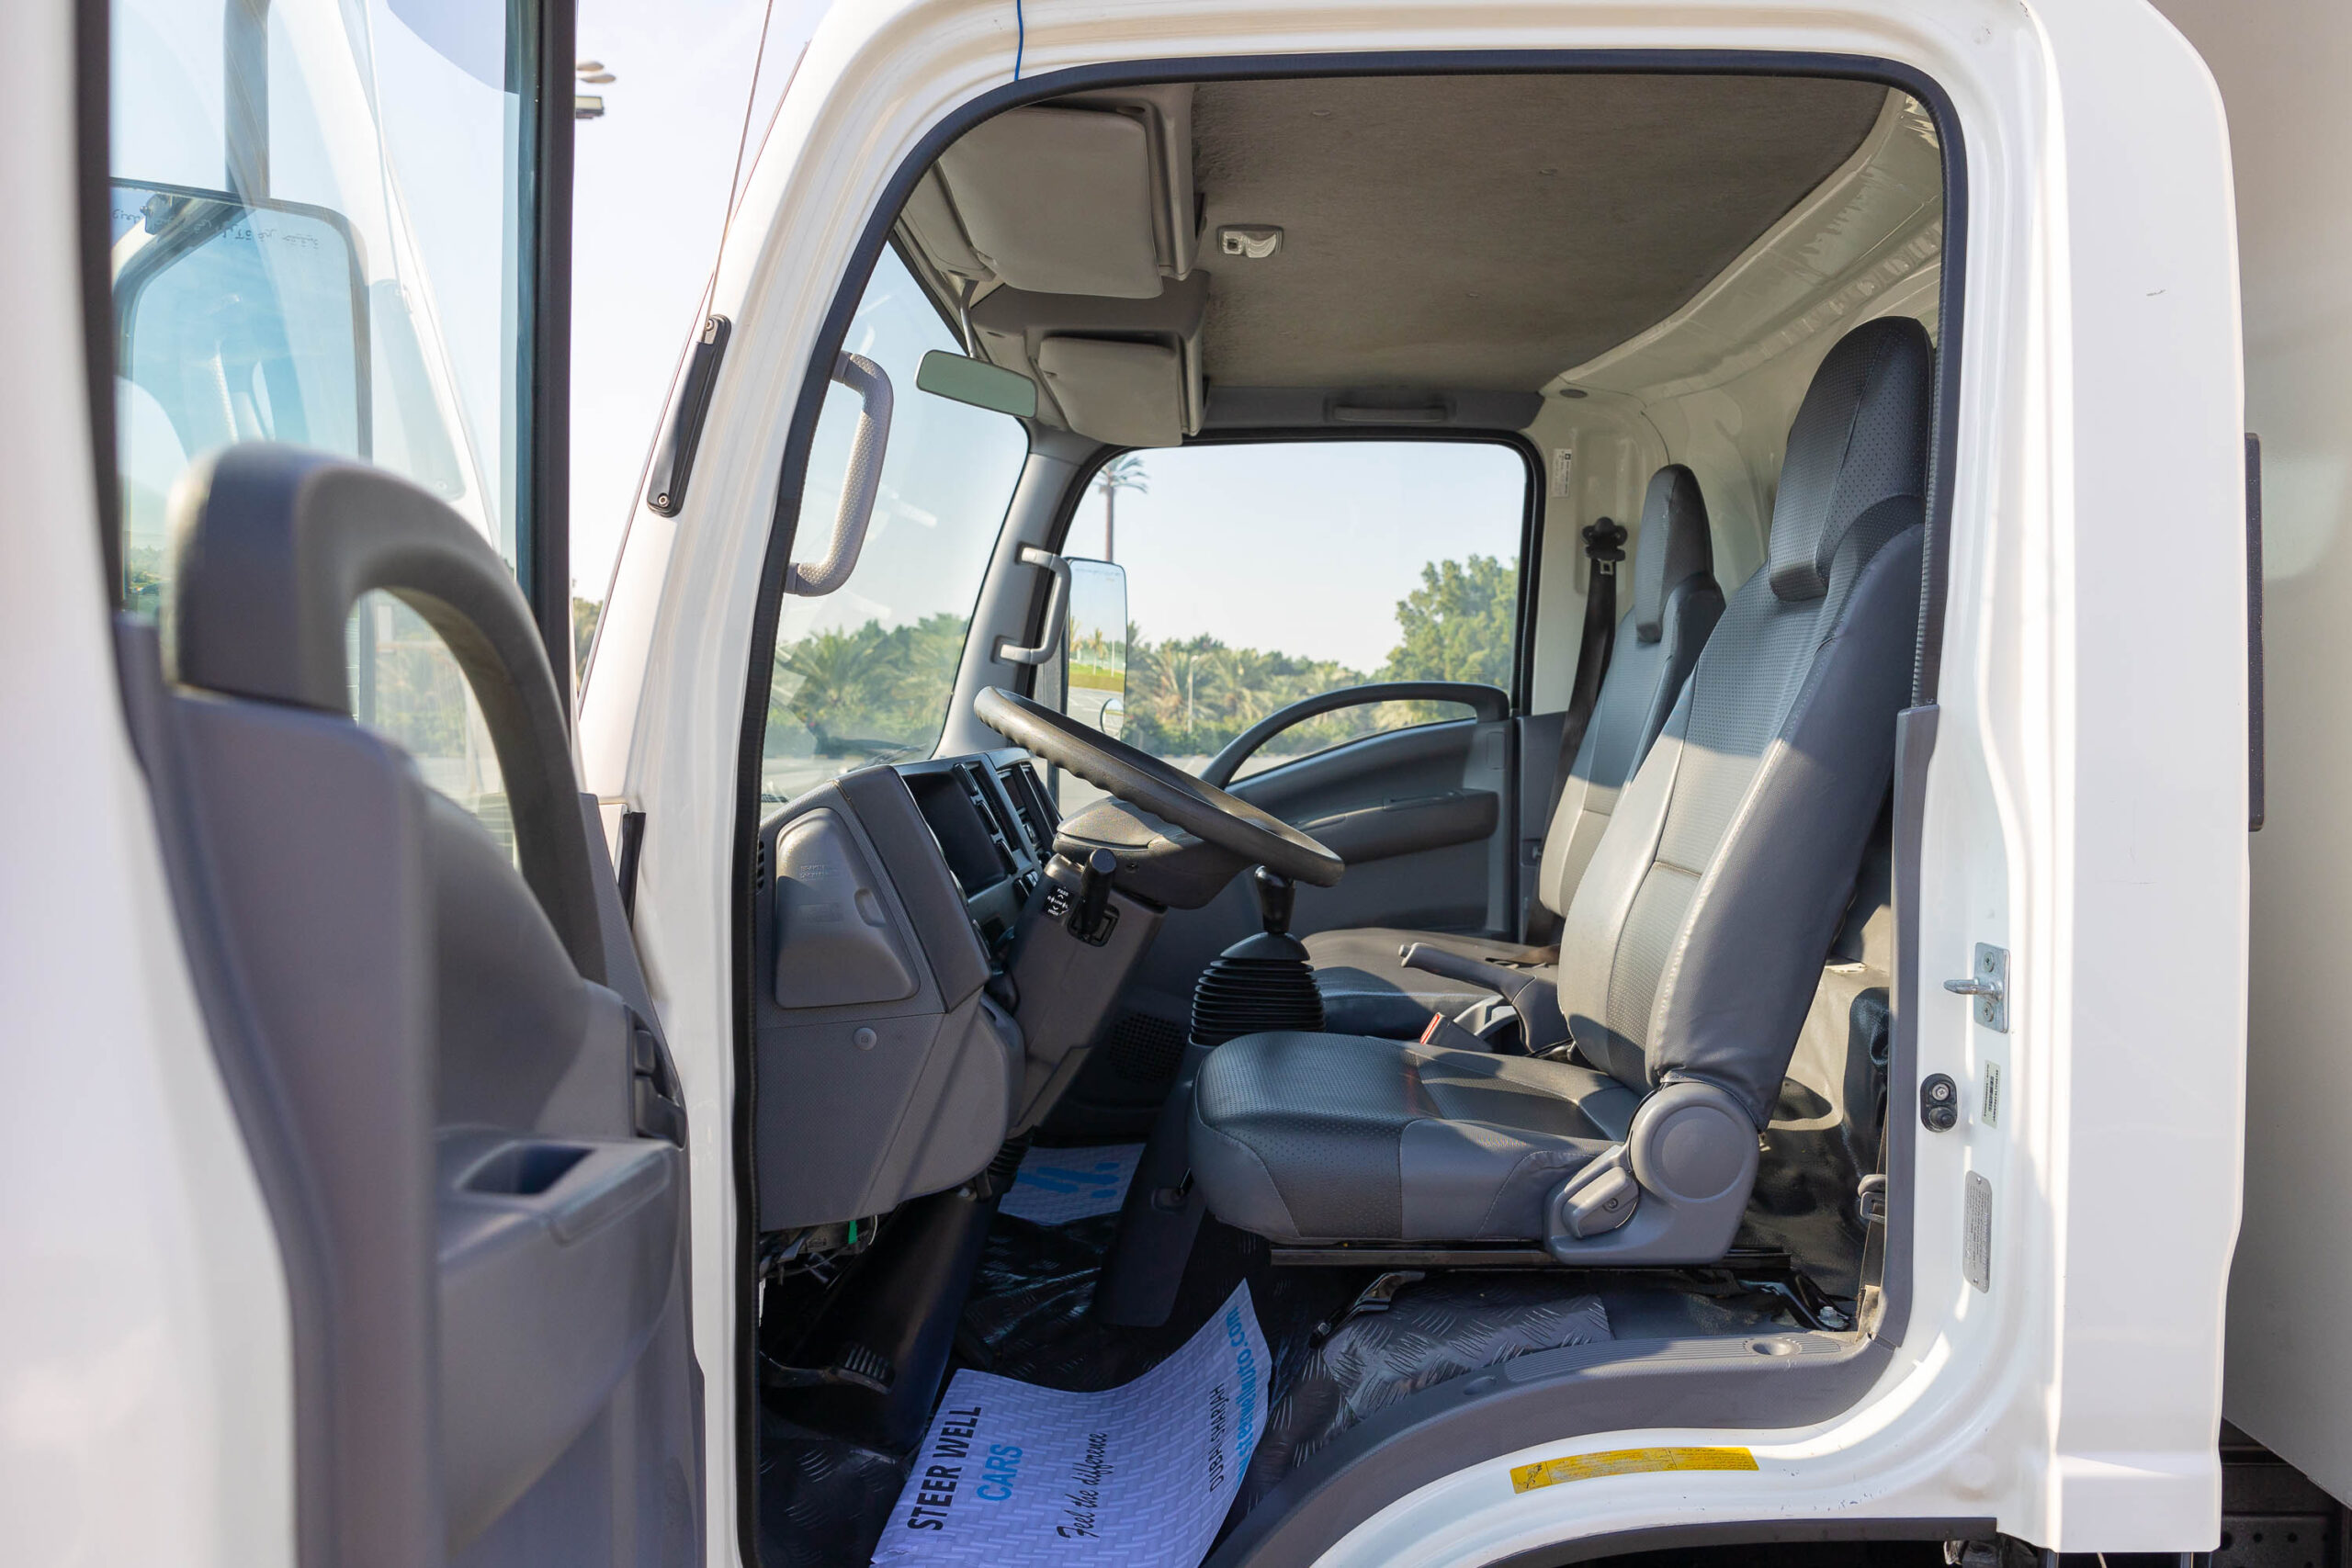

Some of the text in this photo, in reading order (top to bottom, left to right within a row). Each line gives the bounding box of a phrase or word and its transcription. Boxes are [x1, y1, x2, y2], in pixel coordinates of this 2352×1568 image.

[1209, 1383, 1229, 1442] SHARJAH
[907, 1406, 982, 1531] STEER WELL
[977, 1443, 1023, 1502] CARS
[1057, 1432, 1114, 1539] Feel the difference
